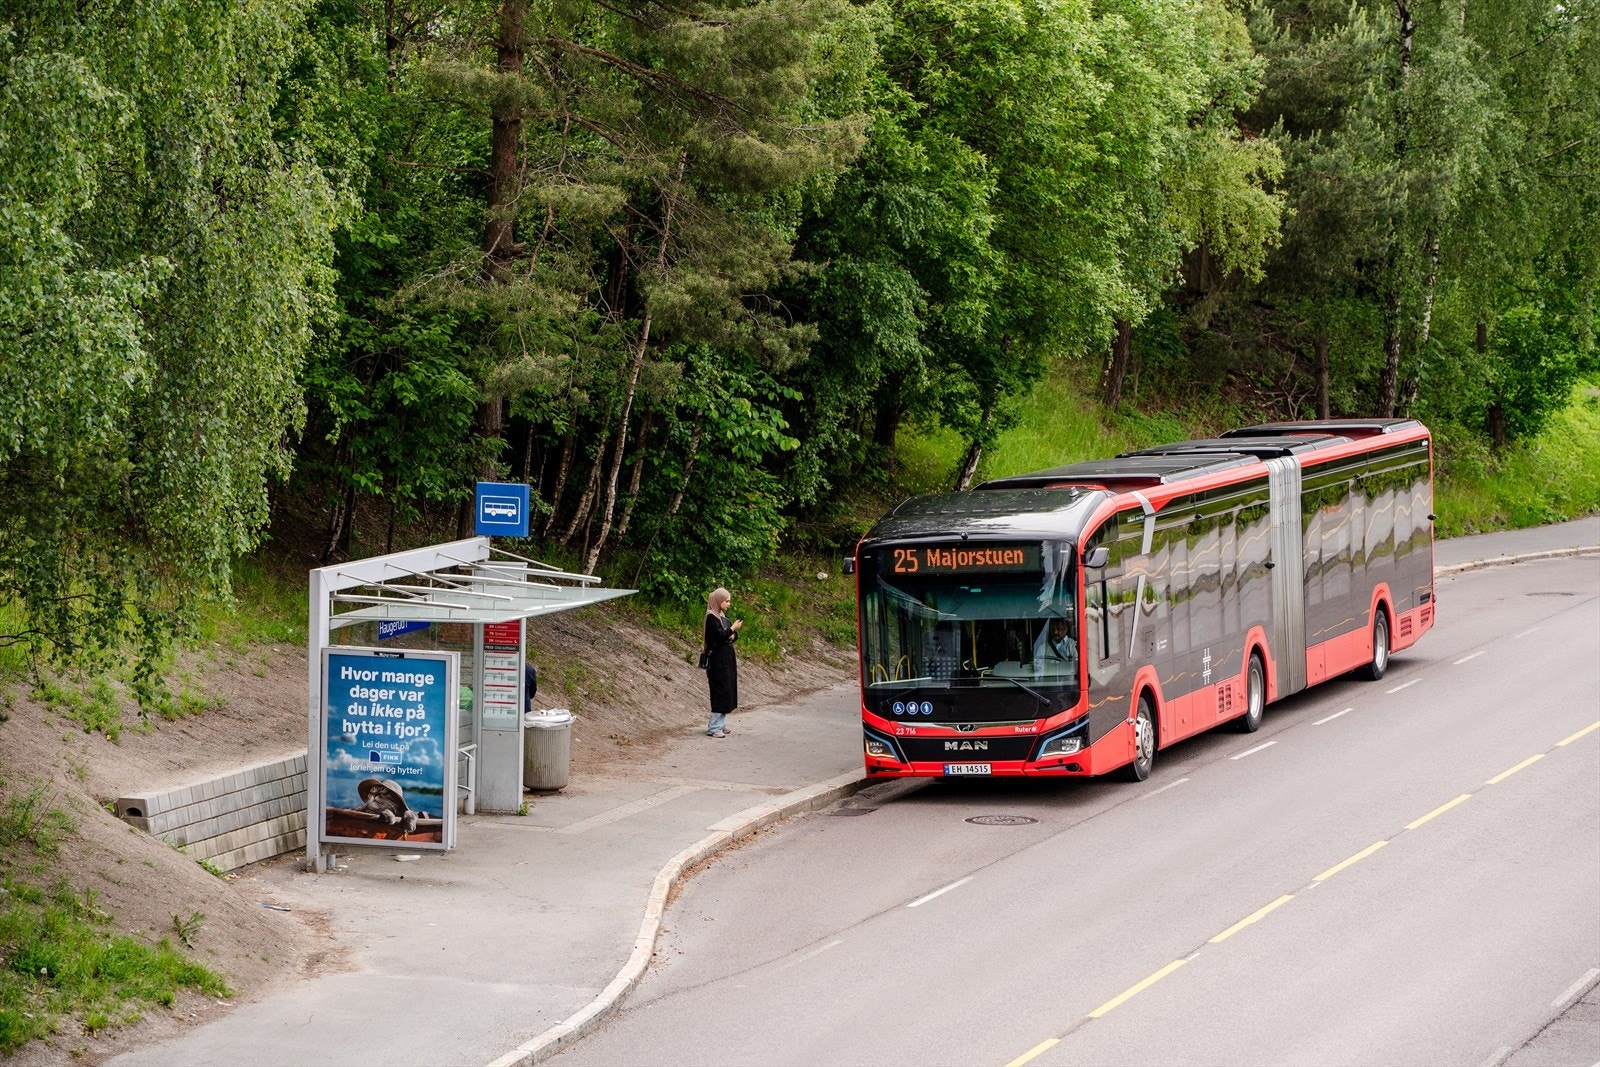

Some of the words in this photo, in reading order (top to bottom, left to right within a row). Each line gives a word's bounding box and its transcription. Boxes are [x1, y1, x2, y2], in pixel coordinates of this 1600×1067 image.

[893, 549, 919, 573] 25
[926, 548, 1024, 570] Majorstuen
[341, 666, 379, 681] Hvor
[381, 671, 434, 687] mange
[349, 685, 396, 702] dager
[399, 690, 424, 702] var
[347, 702, 367, 716] du
[370, 703, 403, 718] ikke
[406, 704, 426, 721] på
[342, 719, 383, 736] hytta
[386, 721, 391, 735] i
[394, 721, 431, 738] fjor?
[896, 727, 904, 735] 23
[905, 727, 916, 735] 716
[362, 740, 373, 748] Lei
[374, 741, 389, 749] den
[400, 743, 410, 751] på
[944, 741, 988, 750] MAN
[350, 763, 385, 773] feriehjem
[386, 766, 396, 774] og
[397, 766, 423, 775] hytter!
[951, 765, 962, 773] EH
[965, 765, 988, 773] 14515
